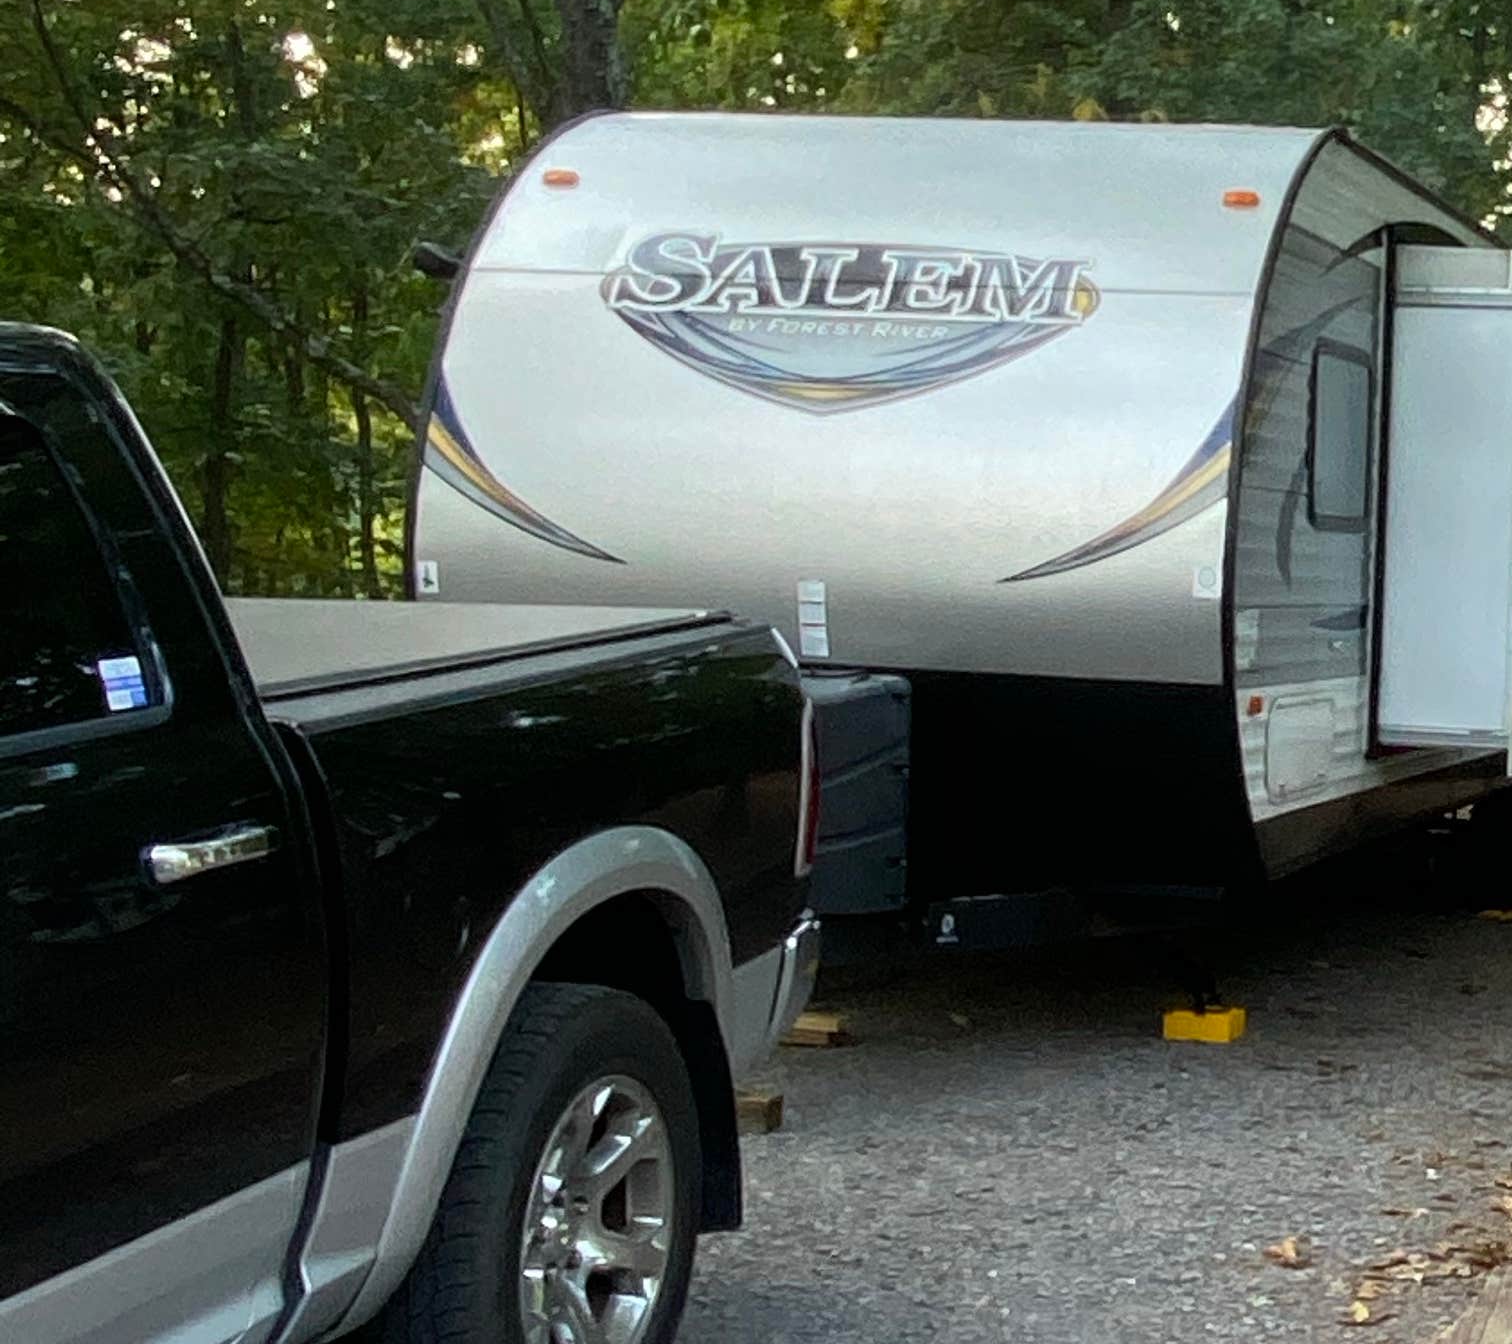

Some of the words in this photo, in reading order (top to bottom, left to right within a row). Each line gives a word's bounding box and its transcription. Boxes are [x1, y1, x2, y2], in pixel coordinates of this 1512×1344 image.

[606, 229, 1097, 326] SALEM
[727, 317, 762, 333] BY
[766, 317, 865, 337] FOREST
[870, 320, 949, 339] RIVER
